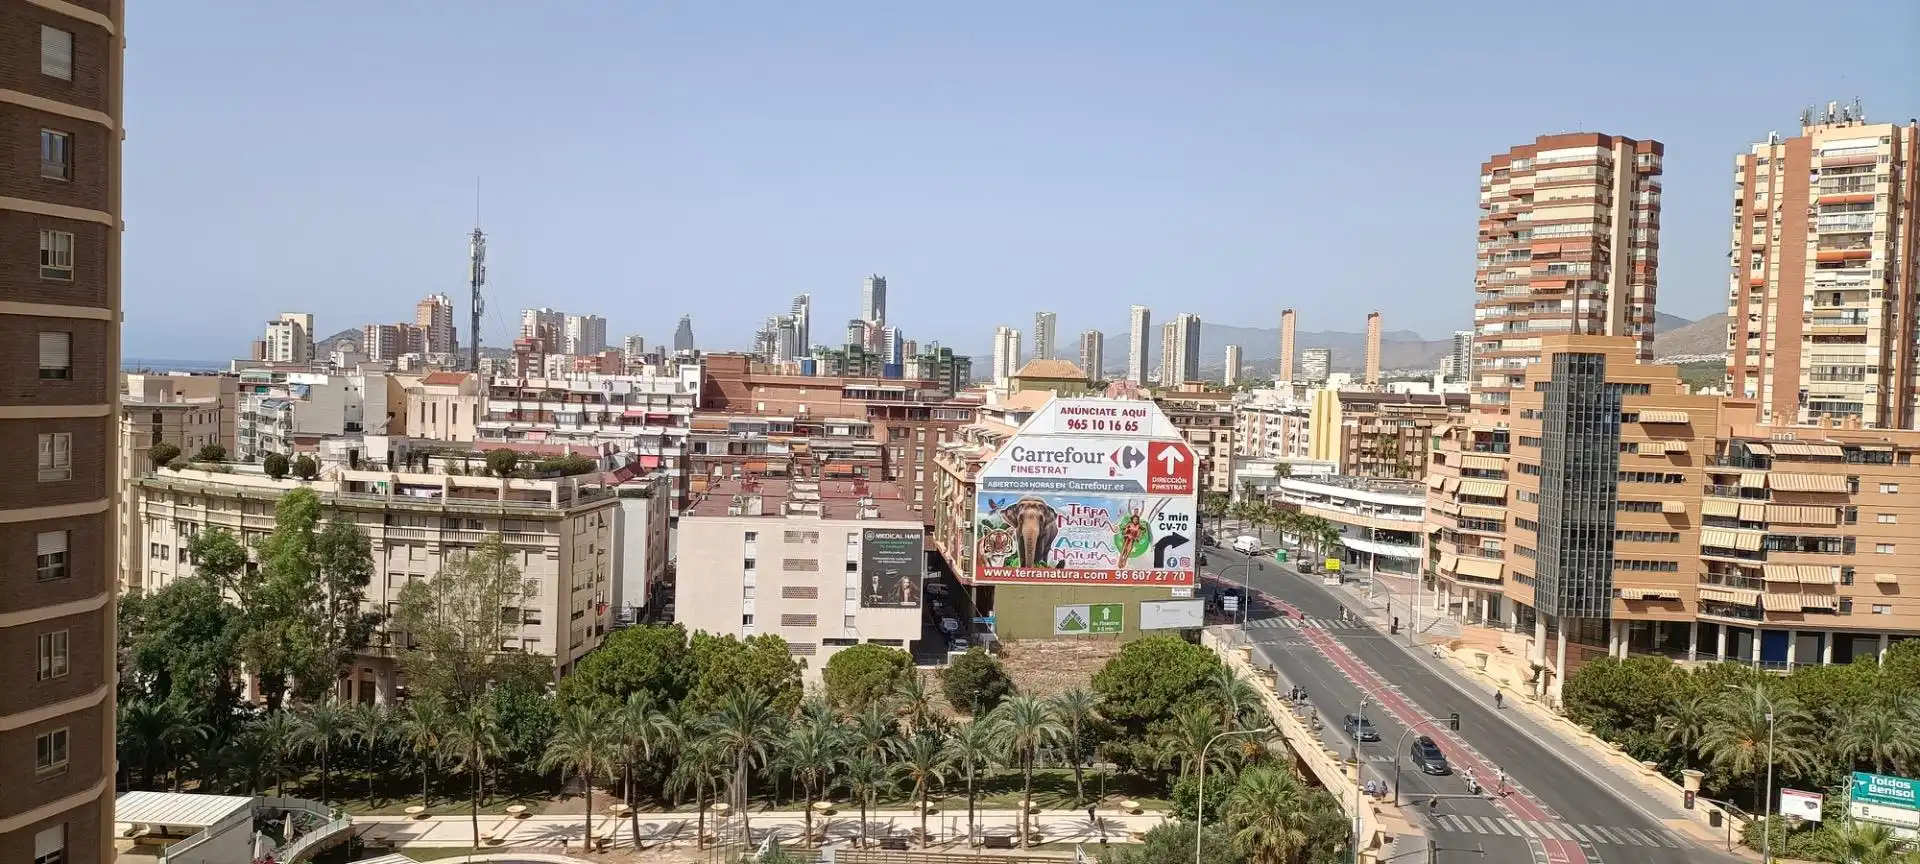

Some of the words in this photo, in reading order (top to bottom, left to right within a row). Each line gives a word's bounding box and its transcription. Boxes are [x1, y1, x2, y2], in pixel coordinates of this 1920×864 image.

[1060, 405, 1117, 416] ANÚNCIATE
[1122, 407, 1146, 417] AQUÍ
[1067, 419, 1088, 430] 965
[1092, 420, 1105, 430] 10
[1109, 420, 1121, 431] 16
[1125, 421, 1138, 431] 65
[1011, 446, 1104, 464] Carrefour
[1011, 465, 1068, 474] FINESTRAT
[1069, 480, 1125, 490] Carrefour.es
[1152, 476, 1187, 484] DIRECCIÓN
[1068, 503, 1109, 518] TERRA
[1158, 512, 1164, 521] 5
[1168, 513, 1189, 521] min
[1057, 514, 1119, 533] NATURA
[1159, 523, 1187, 531] CV-70
[1055, 537, 1116, 552] AQUA
[1054, 548, 1116, 565] NATURA
[984, 569, 1108, 580] www.terranatura.com
[1114, 571, 1128, 580] 96
[1132, 571, 1151, 580] 607
[1156, 572, 1168, 580] 27
[1172, 572, 1185, 581] 70
[1057, 613, 1072, 630] LEROY
[1070, 609, 1087, 629] MERLIN
[1870, 775, 1911, 789] Toldos
[1869, 784, 1915, 799] Benisol
